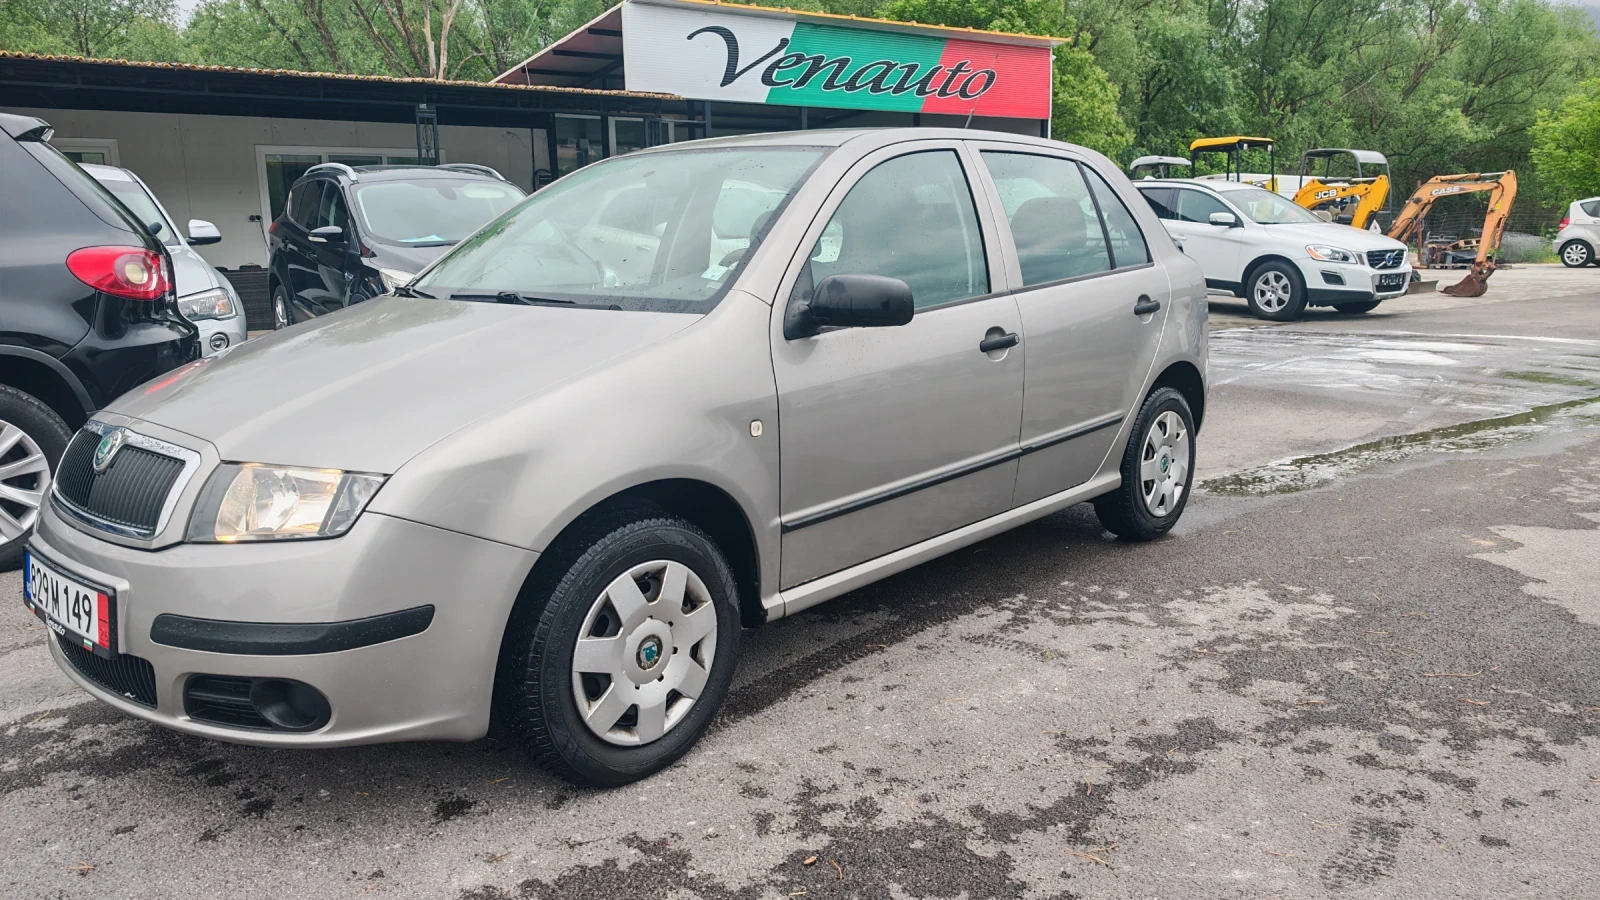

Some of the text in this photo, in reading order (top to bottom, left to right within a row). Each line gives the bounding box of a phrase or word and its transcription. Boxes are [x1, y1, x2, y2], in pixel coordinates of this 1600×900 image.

[686, 27, 997, 99] Venauto
[1315, 189, 1337, 200] JCB
[1431, 186, 1461, 196] CASE
